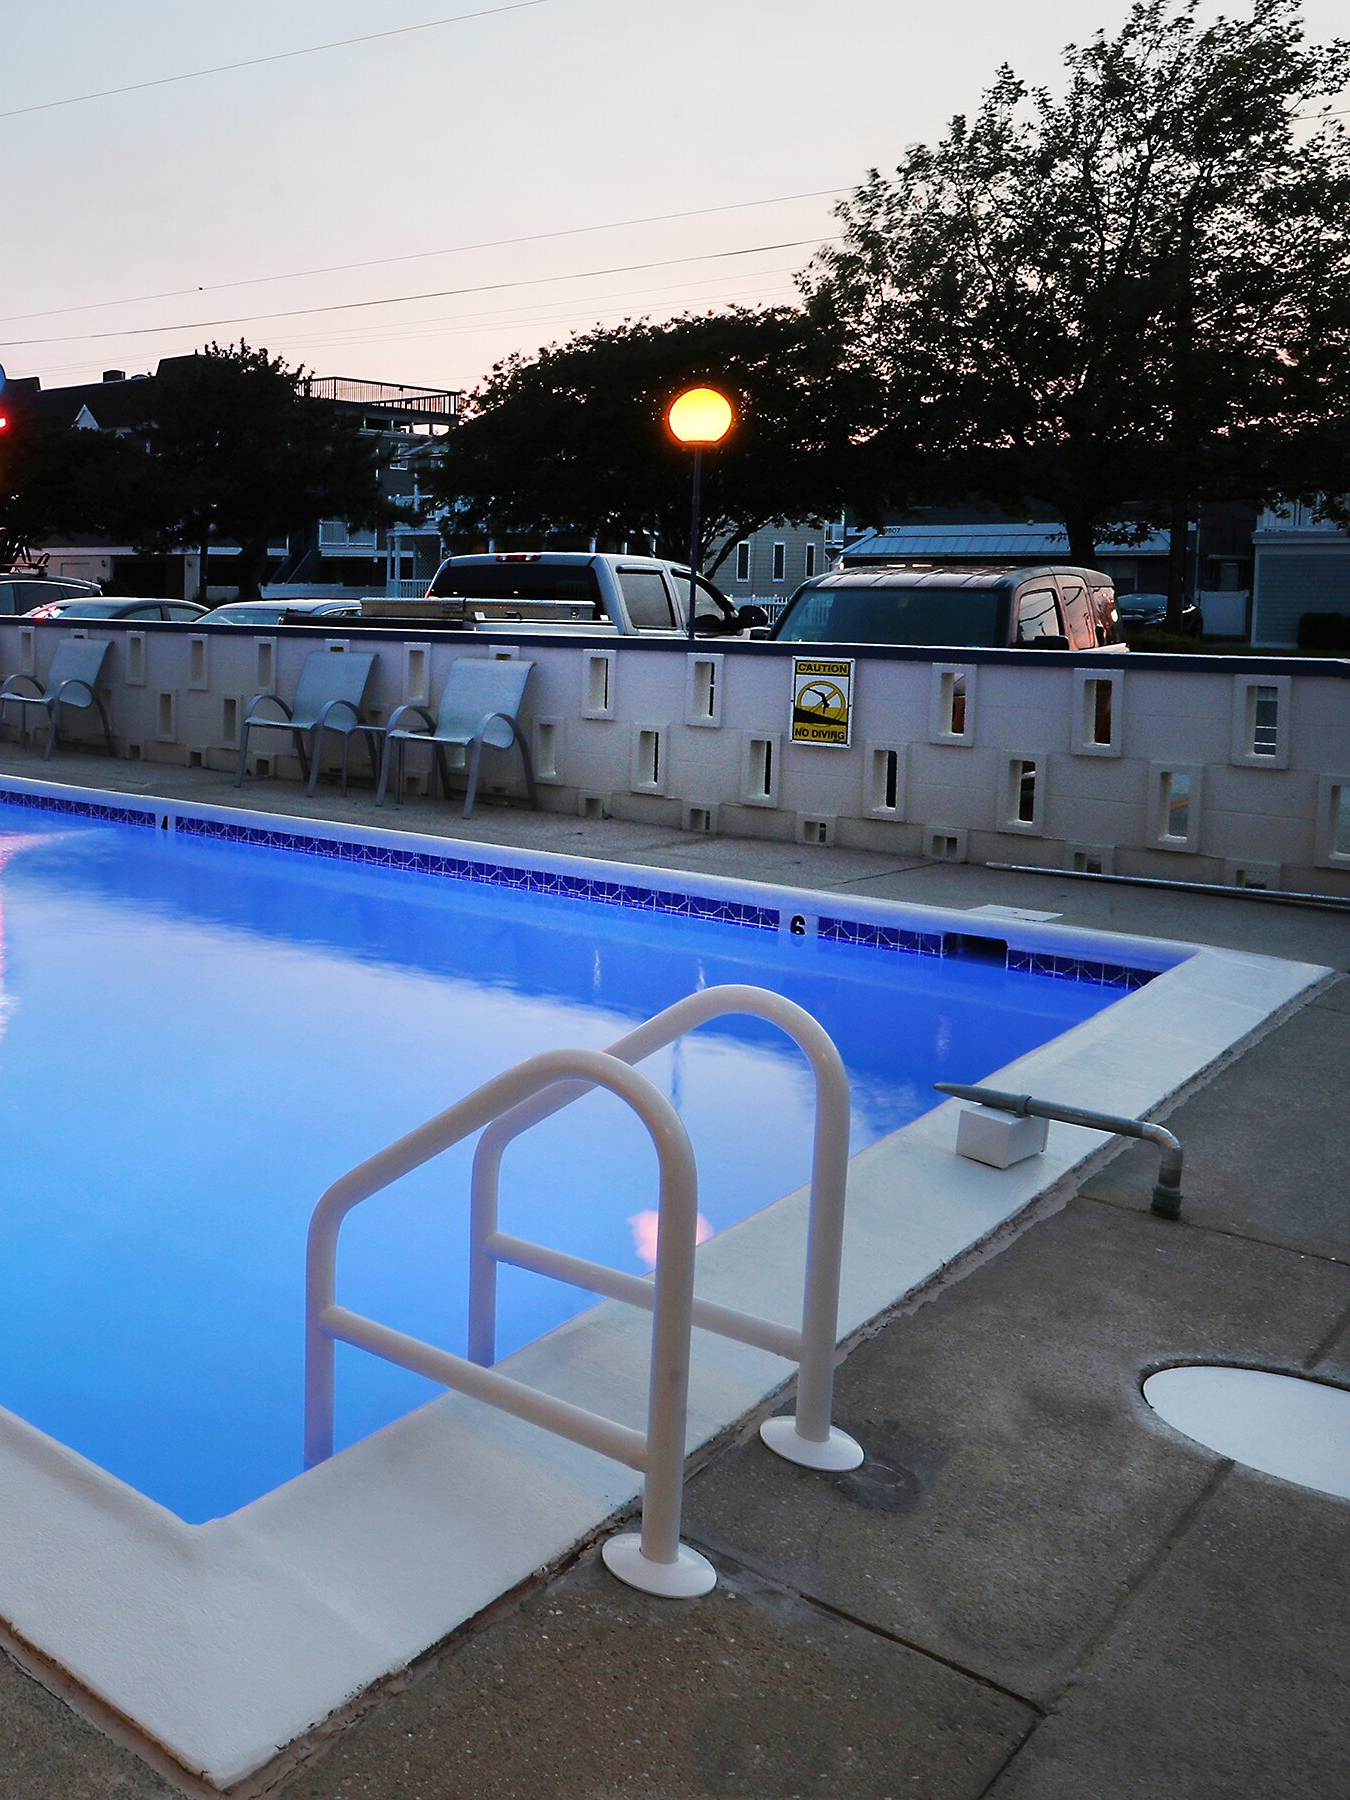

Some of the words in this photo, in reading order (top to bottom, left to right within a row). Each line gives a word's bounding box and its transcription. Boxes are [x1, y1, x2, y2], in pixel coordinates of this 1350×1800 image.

[798, 663, 847, 674] CAUTION
[794, 728, 809, 738] NO
[811, 729, 845, 740] DIVING
[790, 914, 806, 935] 6
